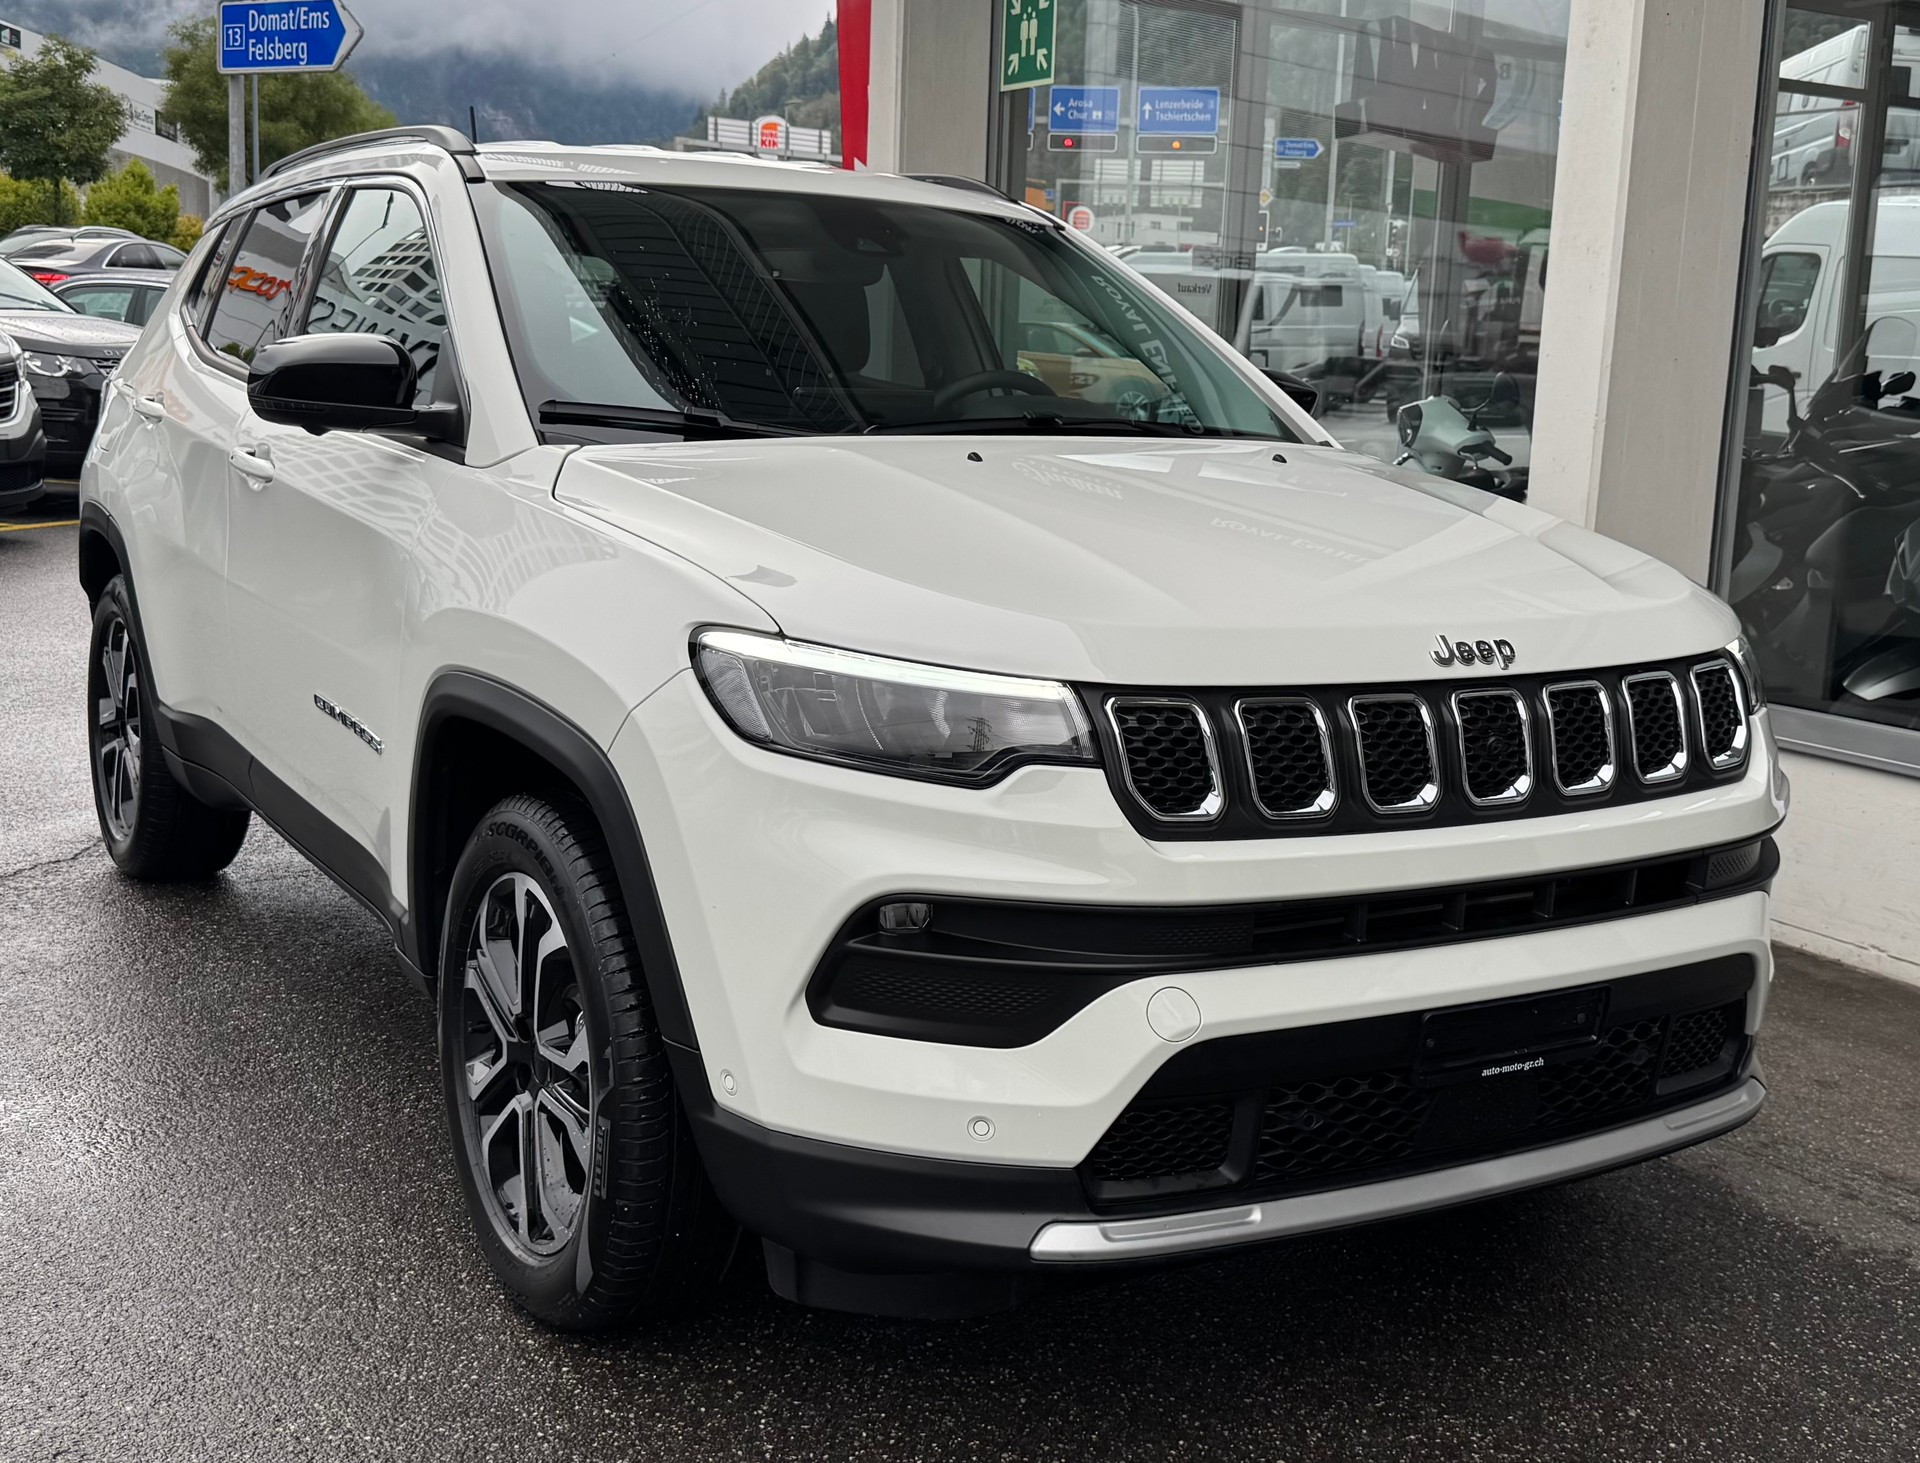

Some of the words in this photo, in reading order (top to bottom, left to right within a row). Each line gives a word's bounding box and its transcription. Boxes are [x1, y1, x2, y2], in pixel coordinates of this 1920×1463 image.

[248, 7, 331, 32] Domat/Ems
[227, 28, 241, 47] 13
[248, 36, 308, 65] Felsberg
[1428, 634, 1516, 671] Jeep
[1481, 1056, 1545, 1077] auto-moto-gr.ch
